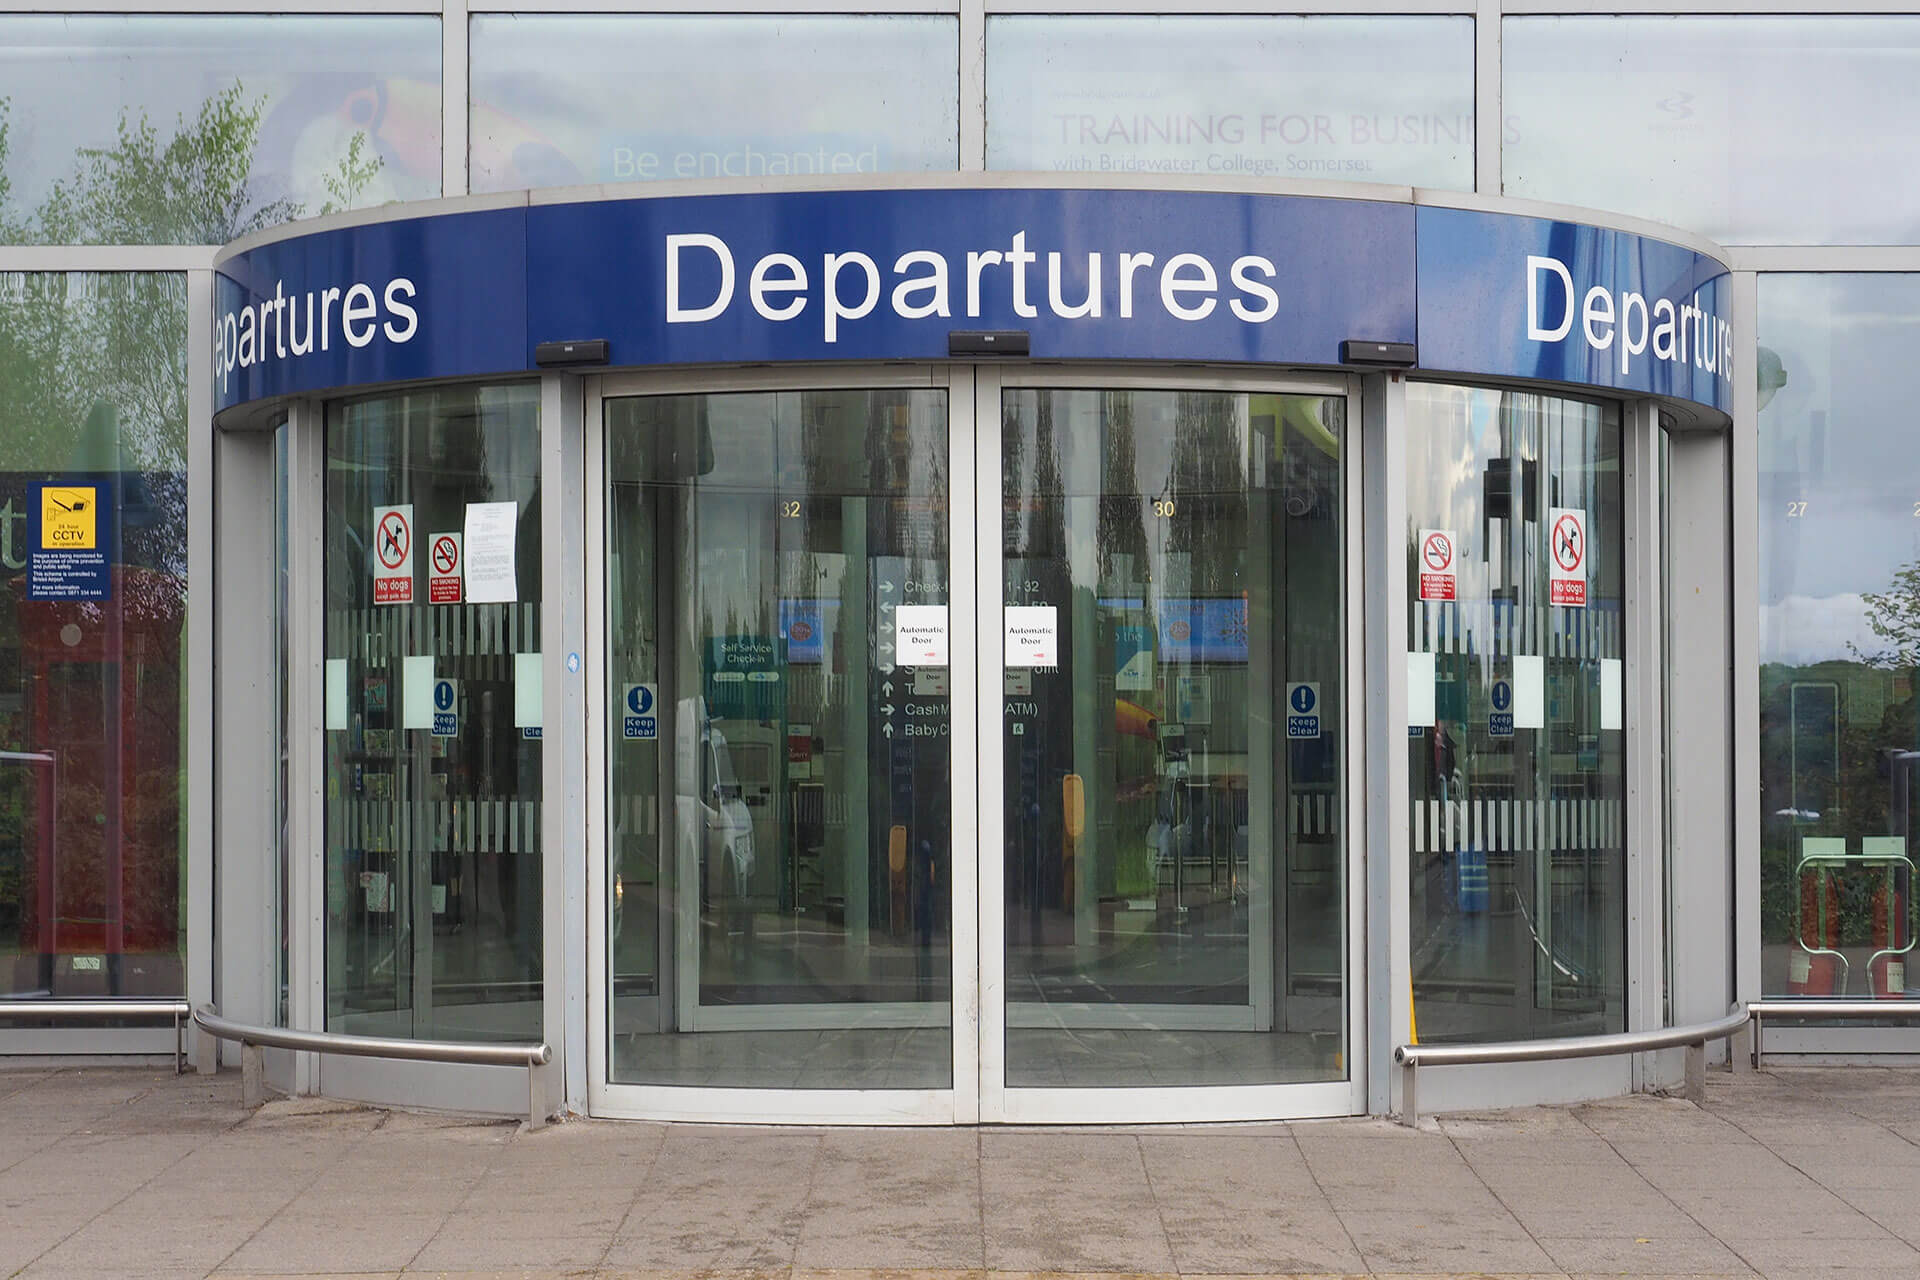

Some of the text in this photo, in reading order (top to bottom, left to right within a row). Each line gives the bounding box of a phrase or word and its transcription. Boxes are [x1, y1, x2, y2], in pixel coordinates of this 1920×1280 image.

[1053, 114, 1522, 145] TRAINING FOR BUSINS
[613, 143, 879, 177] Be enchanted
[1053, 152, 1092, 172] with
[665, 229, 1281, 343] Departures
[782, 500, 801, 518] 32
[1153, 500, 1175, 518] 30
[1787, 501, 1808, 517] 27
[52, 530, 84, 541] CCTV
[377, 579, 409, 592] No dogs
[1024, 580, 1040, 593] 32
[1553, 582, 1583, 595] No dogs
[900, 625, 945, 634] Automatic
[1009, 626, 1053, 634] Automatic
[911, 636, 932, 644] Door
[720, 642, 772, 653] Self Service
[904, 703, 938, 716] Cash
[626, 718, 653, 728] Keep
[1290, 718, 1316, 728] Keep
[1490, 715, 1512, 725] Keep
[626, 728, 654, 736] Clear
[904, 723, 938, 738] Baby
[1289, 727, 1317, 736] Clear
[1490, 725, 1512, 734] Clear
